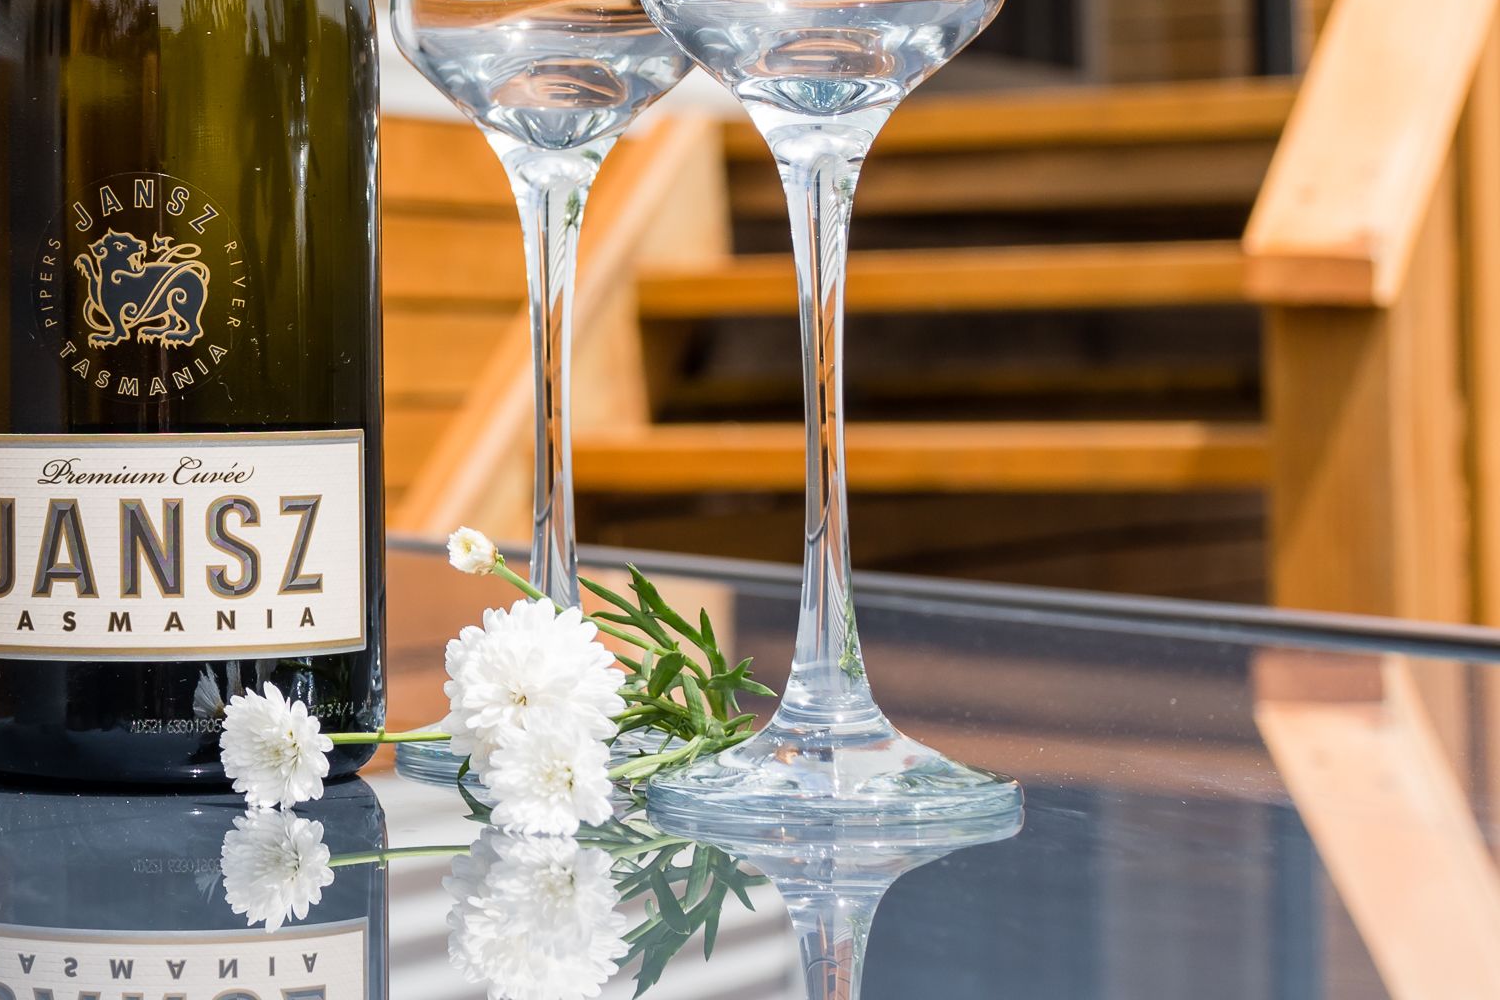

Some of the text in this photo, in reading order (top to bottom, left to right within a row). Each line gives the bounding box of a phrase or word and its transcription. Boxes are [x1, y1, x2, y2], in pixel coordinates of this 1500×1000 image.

[73, 179, 219, 234] JANSZ
[39, 238, 61, 327] PIPERS
[224, 240, 246, 328] RIVER
[59, 340, 228, 396] TASMANIA
[37, 456, 254, 485] Premium Cuvée
